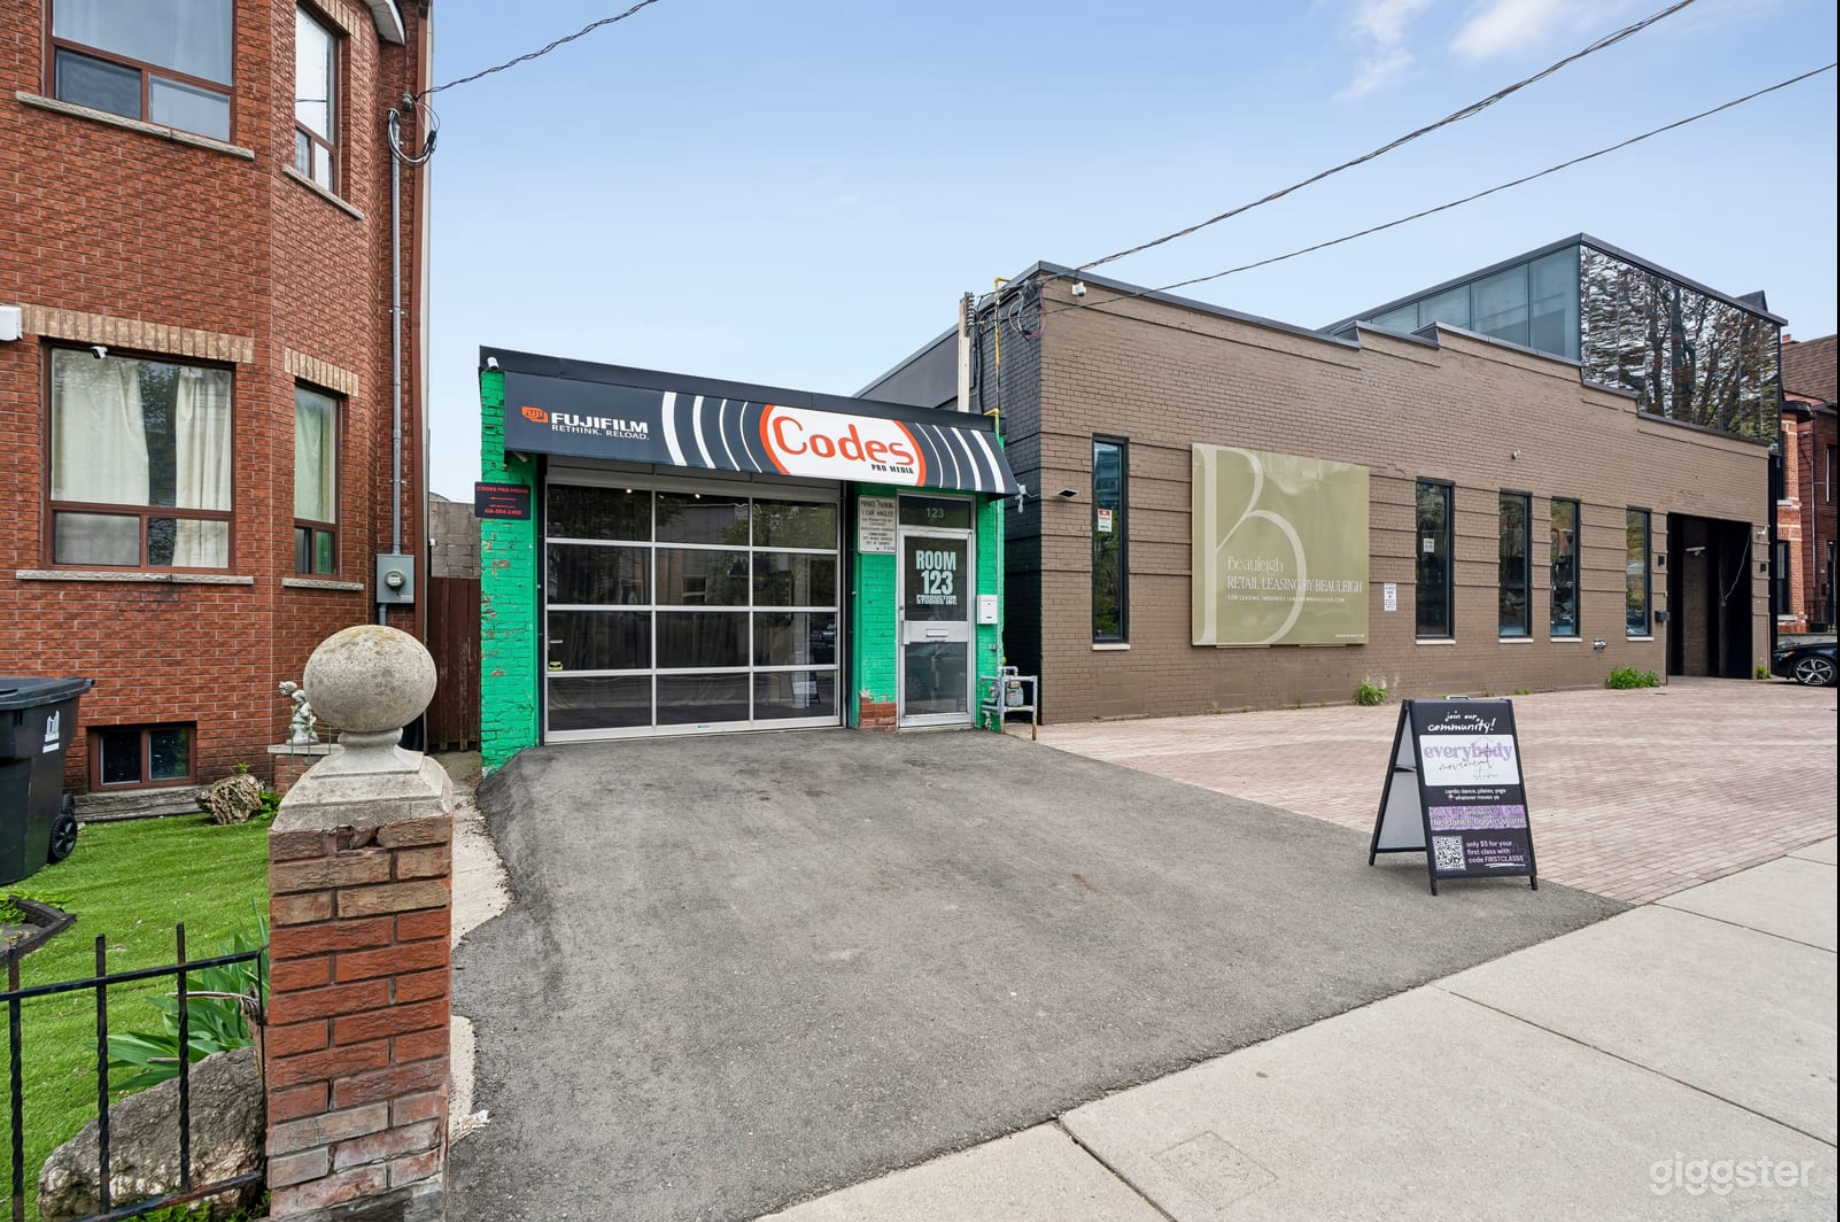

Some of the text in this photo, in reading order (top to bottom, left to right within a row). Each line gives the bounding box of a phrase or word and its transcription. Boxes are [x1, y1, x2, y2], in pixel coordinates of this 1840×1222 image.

[551, 412, 649, 434] FUJIFILM
[551, 424, 650, 441] RETHINK. RELOAD.
[773, 416, 914, 466] Codes
[871, 464, 914, 474] PRO MEDIA
[925, 507, 945, 519] 123
[915, 550, 956, 571] ROOM
[921, 570, 953, 595] 123
[1227, 575, 1363, 593] RETAIL LEASING BY BEAULEIGH
[1444, 710, 1461, 722] join
[1427, 718, 1496, 734] community!
[1423, 742, 1512, 761] everybody
[1466, 841, 1479, 849] only
